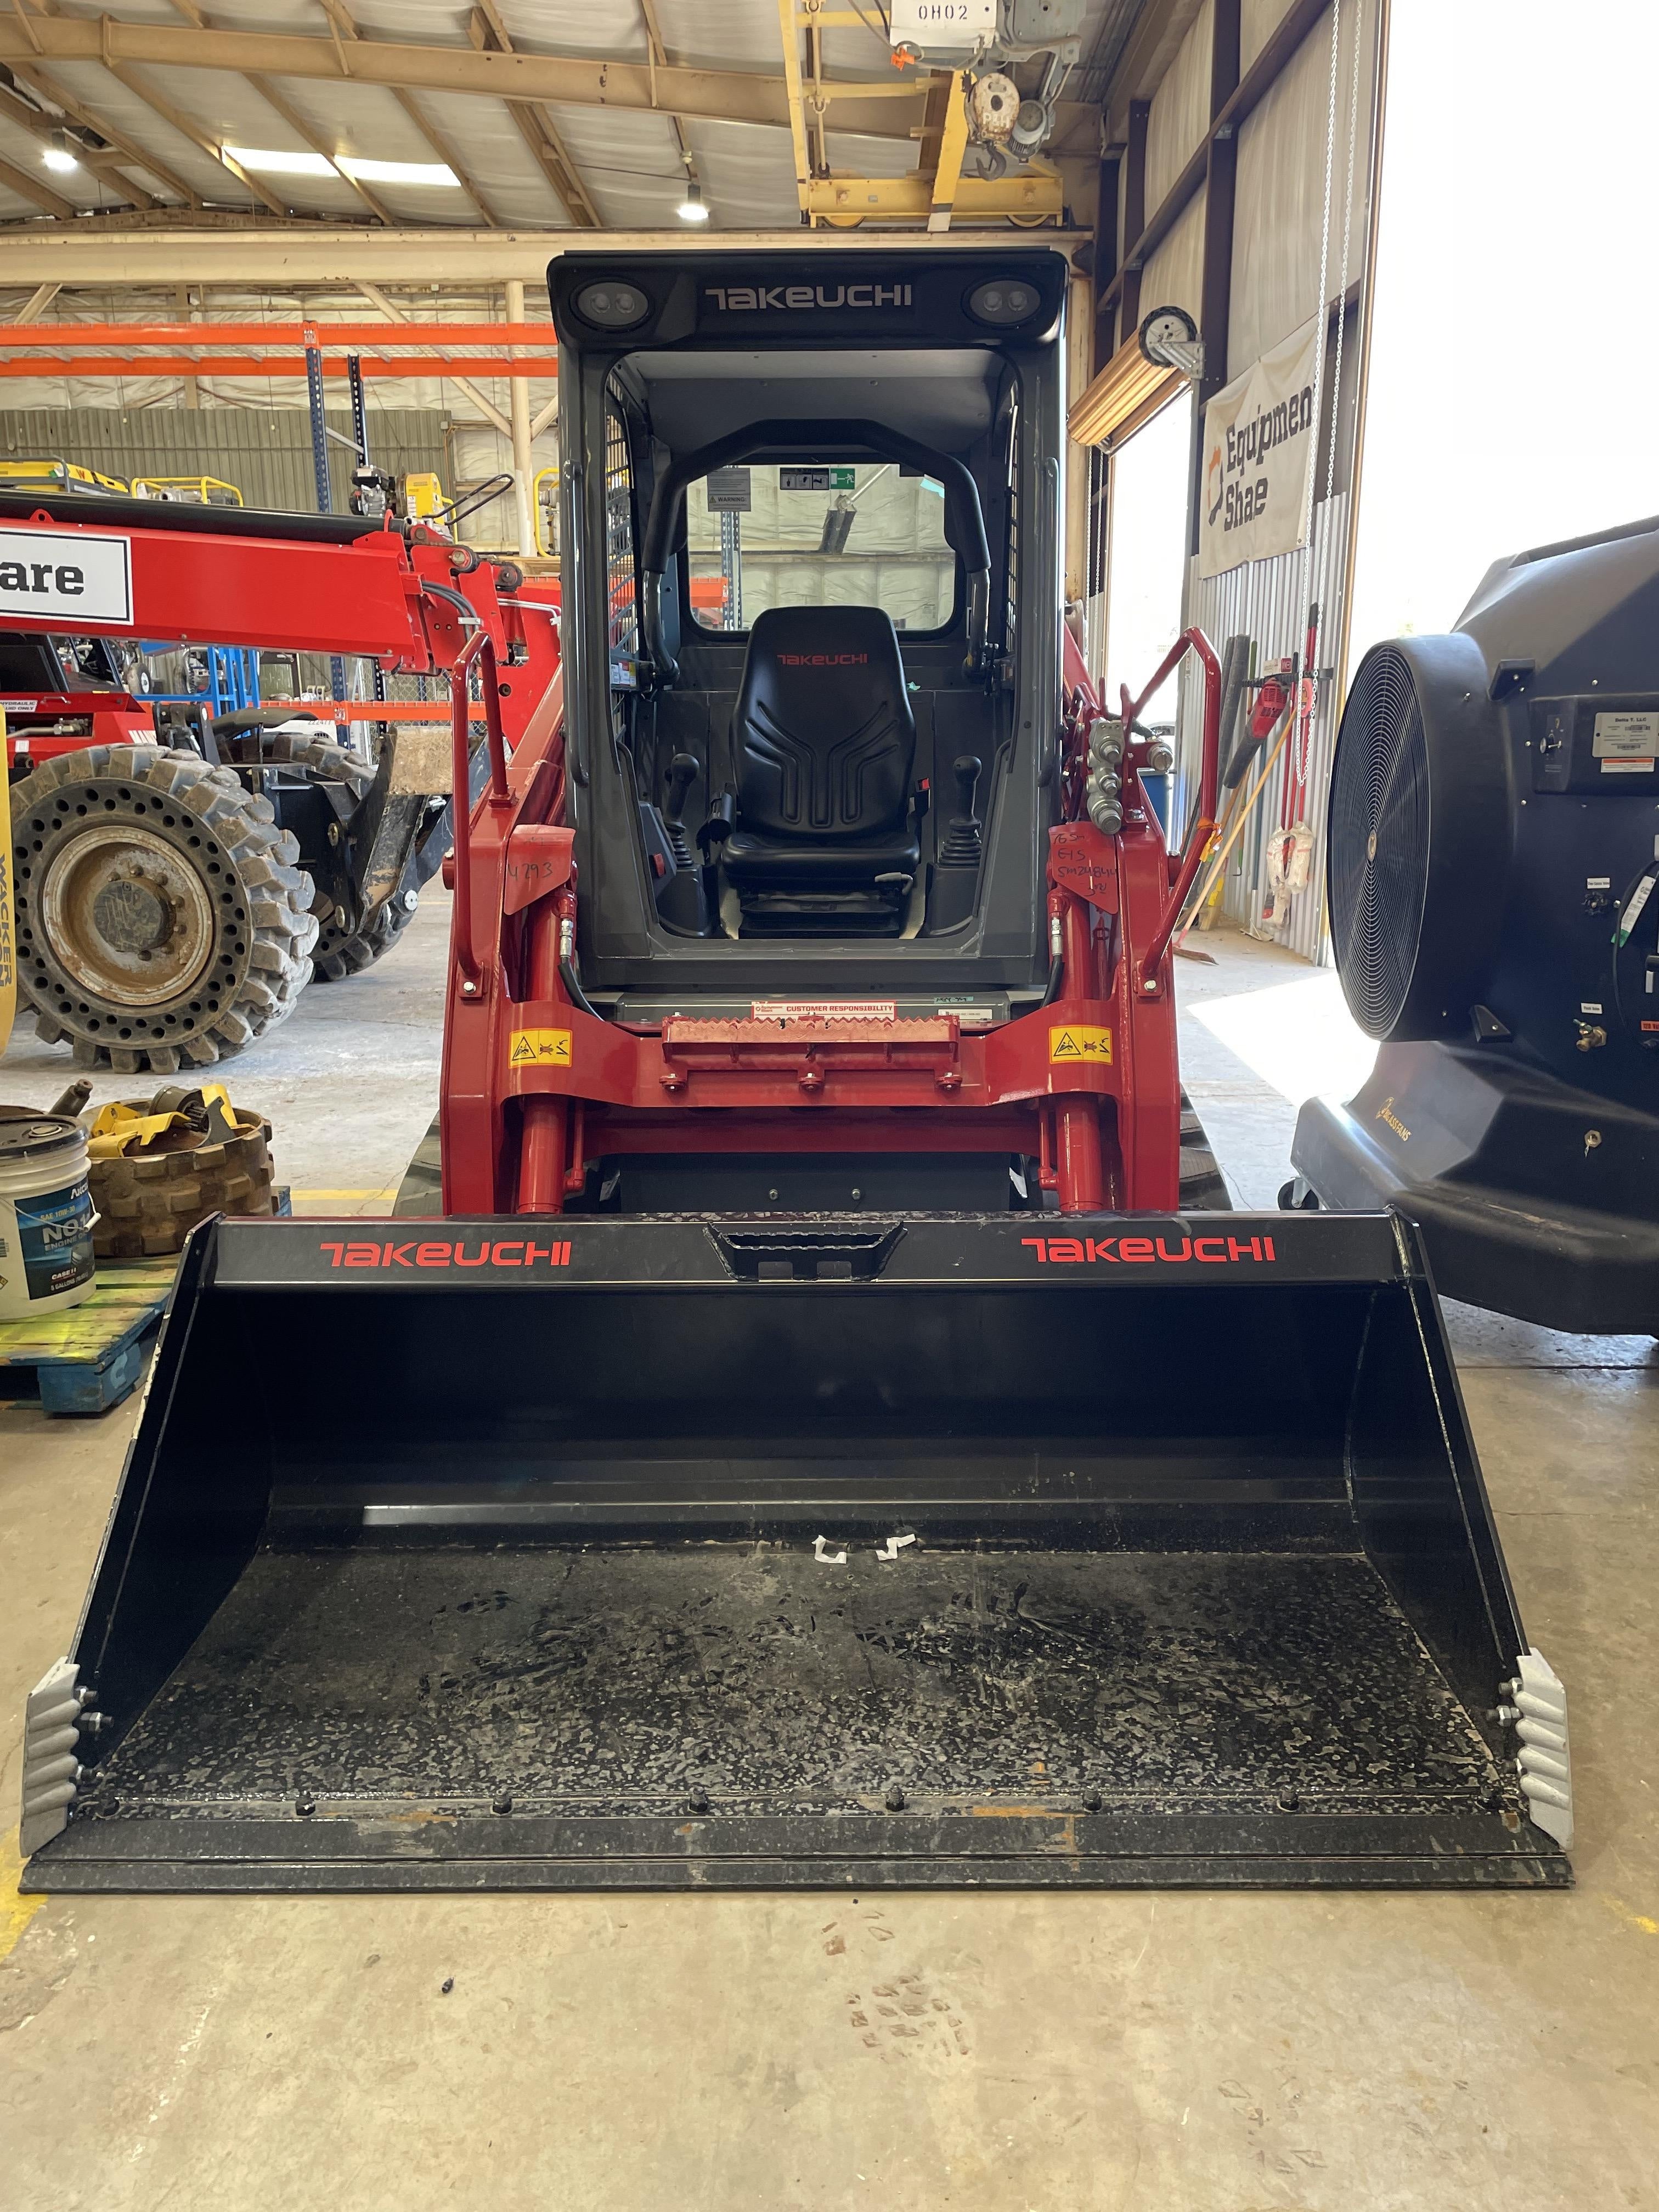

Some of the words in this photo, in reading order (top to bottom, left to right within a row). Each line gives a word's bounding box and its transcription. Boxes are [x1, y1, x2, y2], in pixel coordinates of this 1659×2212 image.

[983, 112, 1009, 128] P&H
[1226, 383, 1314, 477] Equipmen
[41, 1213, 53, 1221] SAE
[44, 1235, 78, 1252] ENGINE
